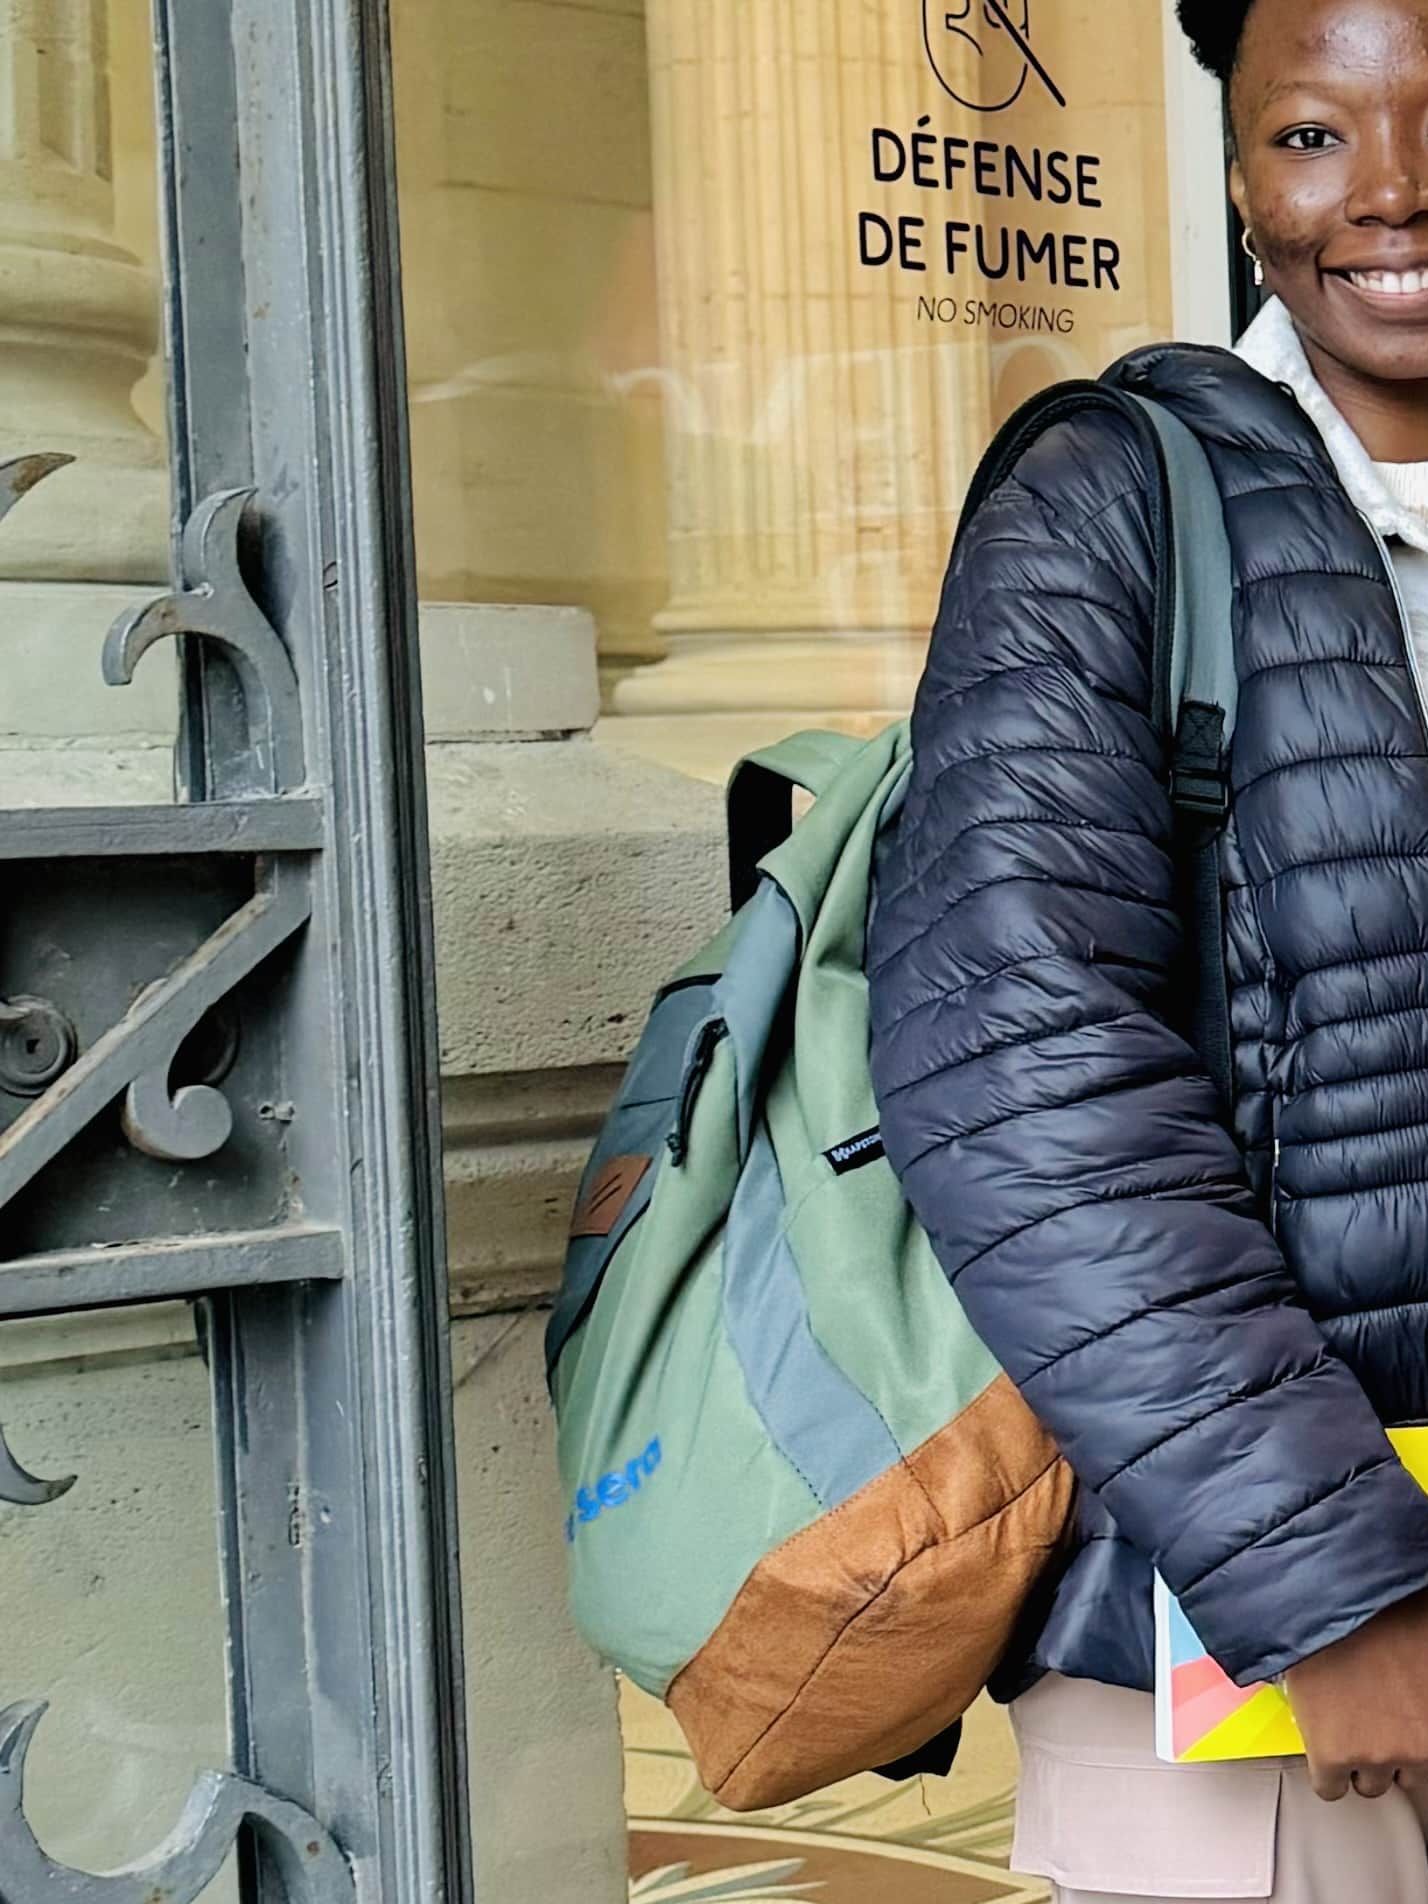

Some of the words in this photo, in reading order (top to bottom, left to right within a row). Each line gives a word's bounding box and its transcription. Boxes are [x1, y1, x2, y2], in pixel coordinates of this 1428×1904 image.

[871, 114, 1103, 208] DÉFENSE
[857, 211, 927, 271] DE
[944, 221, 1121, 292] FUMER
[917, 295, 957, 324] NO
[962, 298, 1075, 335] SMOKING
